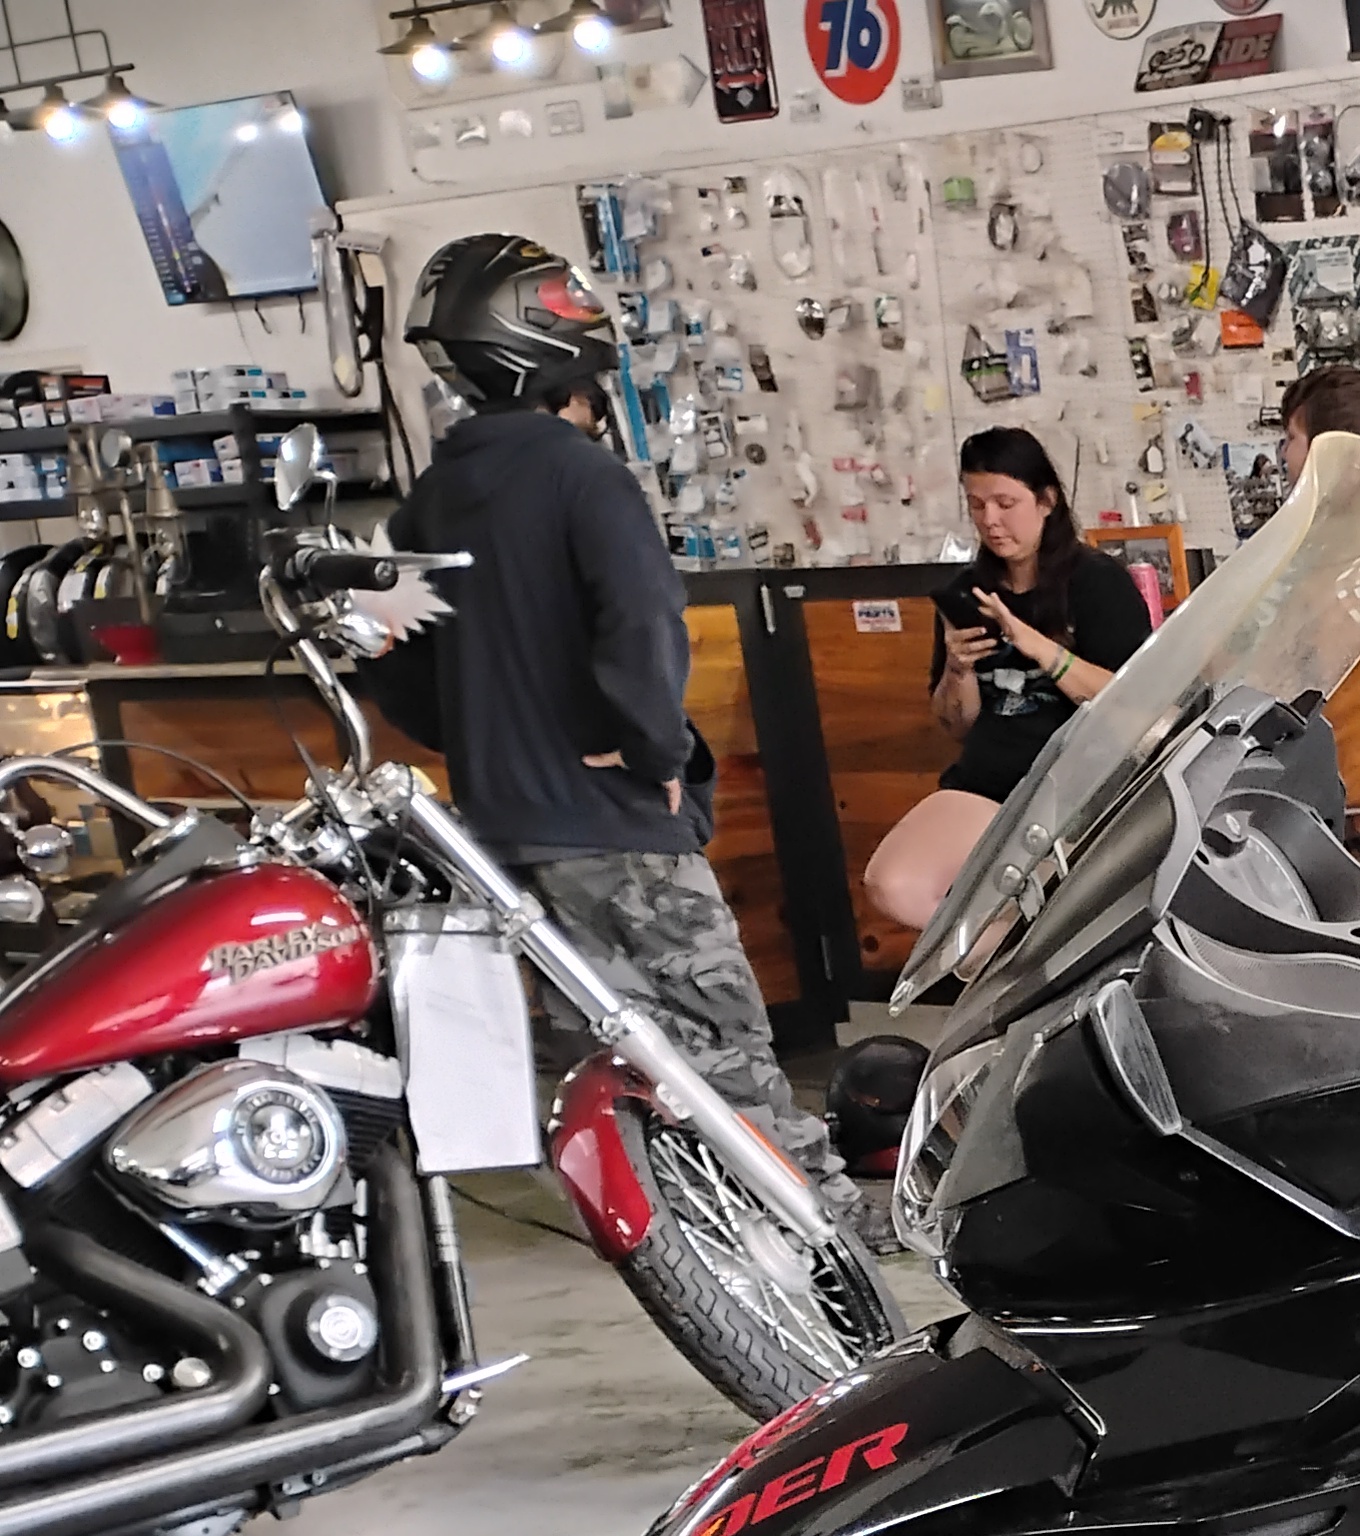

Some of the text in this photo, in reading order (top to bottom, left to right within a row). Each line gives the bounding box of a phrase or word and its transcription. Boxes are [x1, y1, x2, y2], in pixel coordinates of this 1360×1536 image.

[820, 0, 884, 71] 76
[211, 922, 318, 969] HARLEY
[231, 925, 362, 985] DAVIDSON
